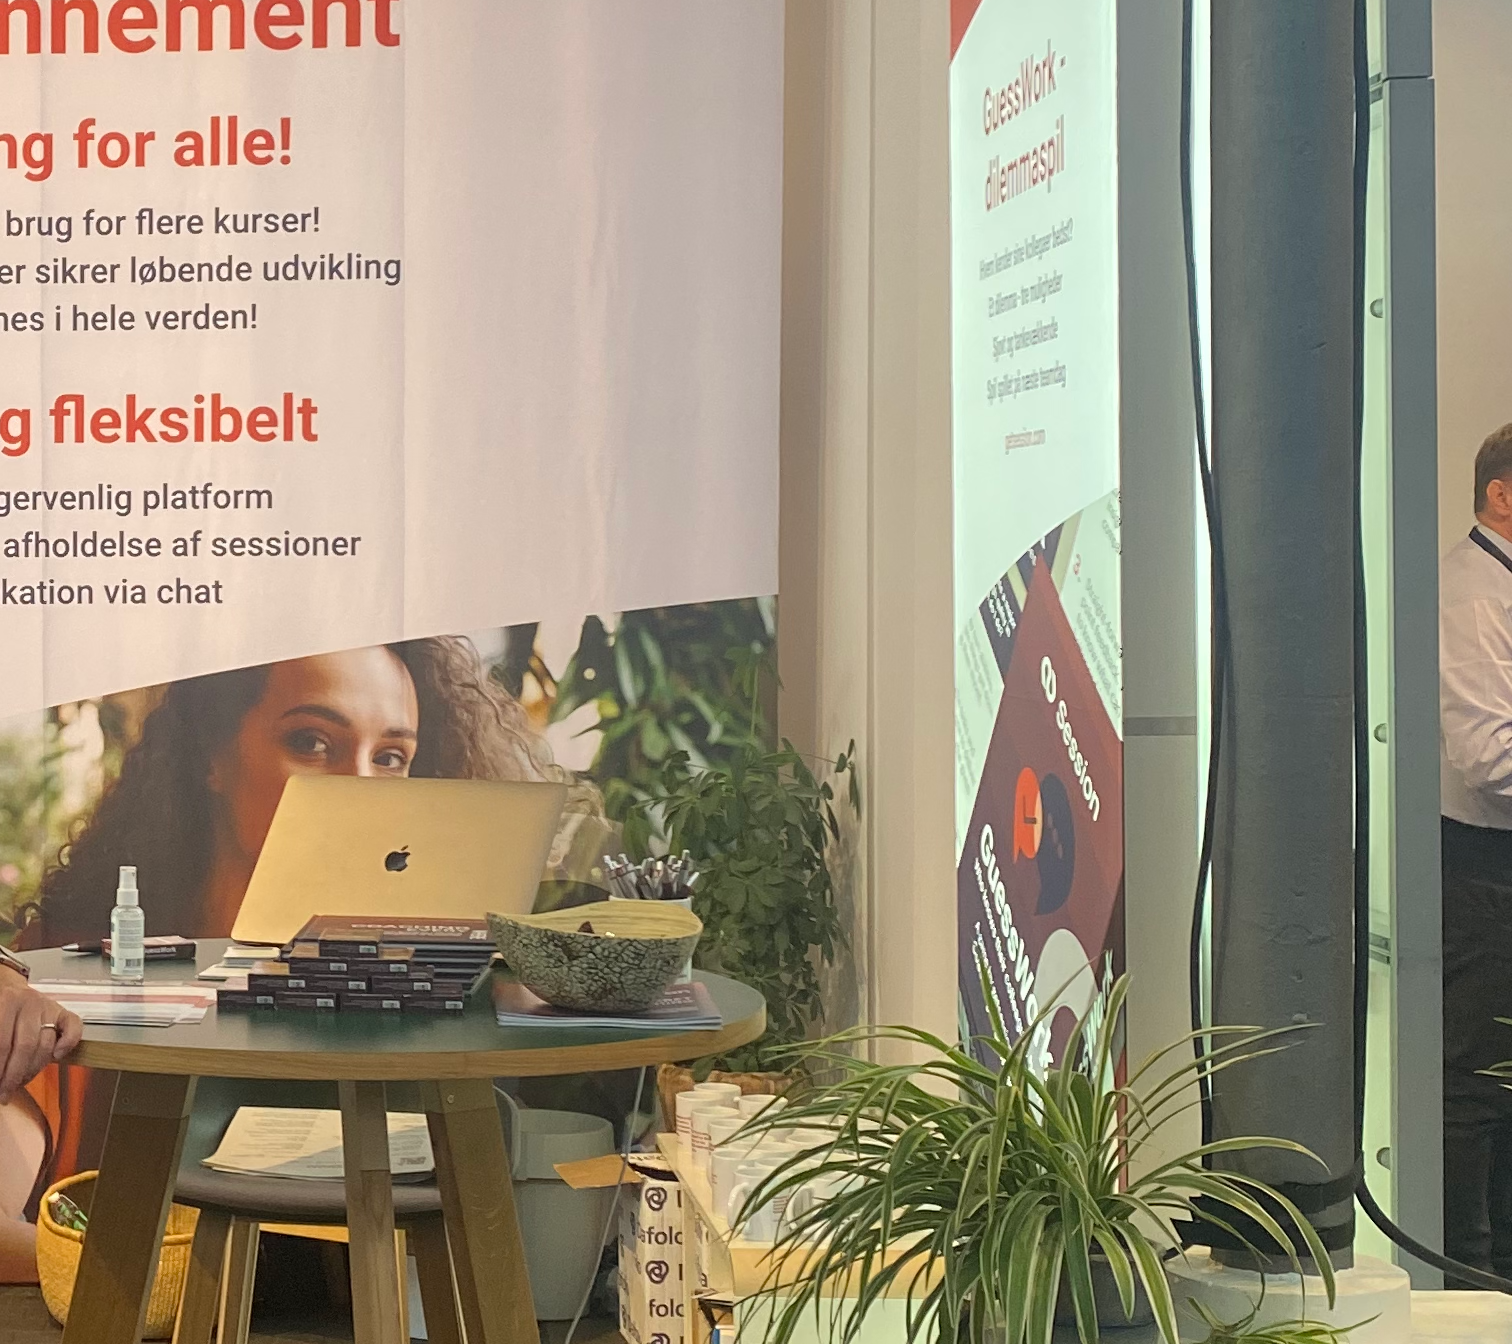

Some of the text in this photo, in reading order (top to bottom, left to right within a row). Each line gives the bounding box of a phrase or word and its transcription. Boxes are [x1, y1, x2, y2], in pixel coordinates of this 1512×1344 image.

[983, 38, 1056, 136] GuessWork
[73, 118, 155, 168] for
[174, 115, 291, 167] alle!
[985, 114, 1065, 212] dilemmaspil
[6, 210, 72, 243] brug
[83, 209, 126, 236] for
[135, 208, 203, 235] flere
[215, 207, 319, 234] kurser!
[36, 257, 120, 284] sikrer
[131, 255, 252, 285] løbende
[263, 253, 401, 286] udvikling
[56, 305, 61, 331] i
[73, 304, 135, 331] hele
[145, 303, 256, 330] verden!
[49, 392, 318, 443] fleksibelt
[143, 482, 272, 516] platform
[4, 531, 161, 558] afholdelse
[172, 530, 202, 557] af
[211, 530, 361, 556] sessioner
[104, 579, 146, 604] via
[157, 577, 223, 604] chat
[1055, 699, 1102, 822] Session
